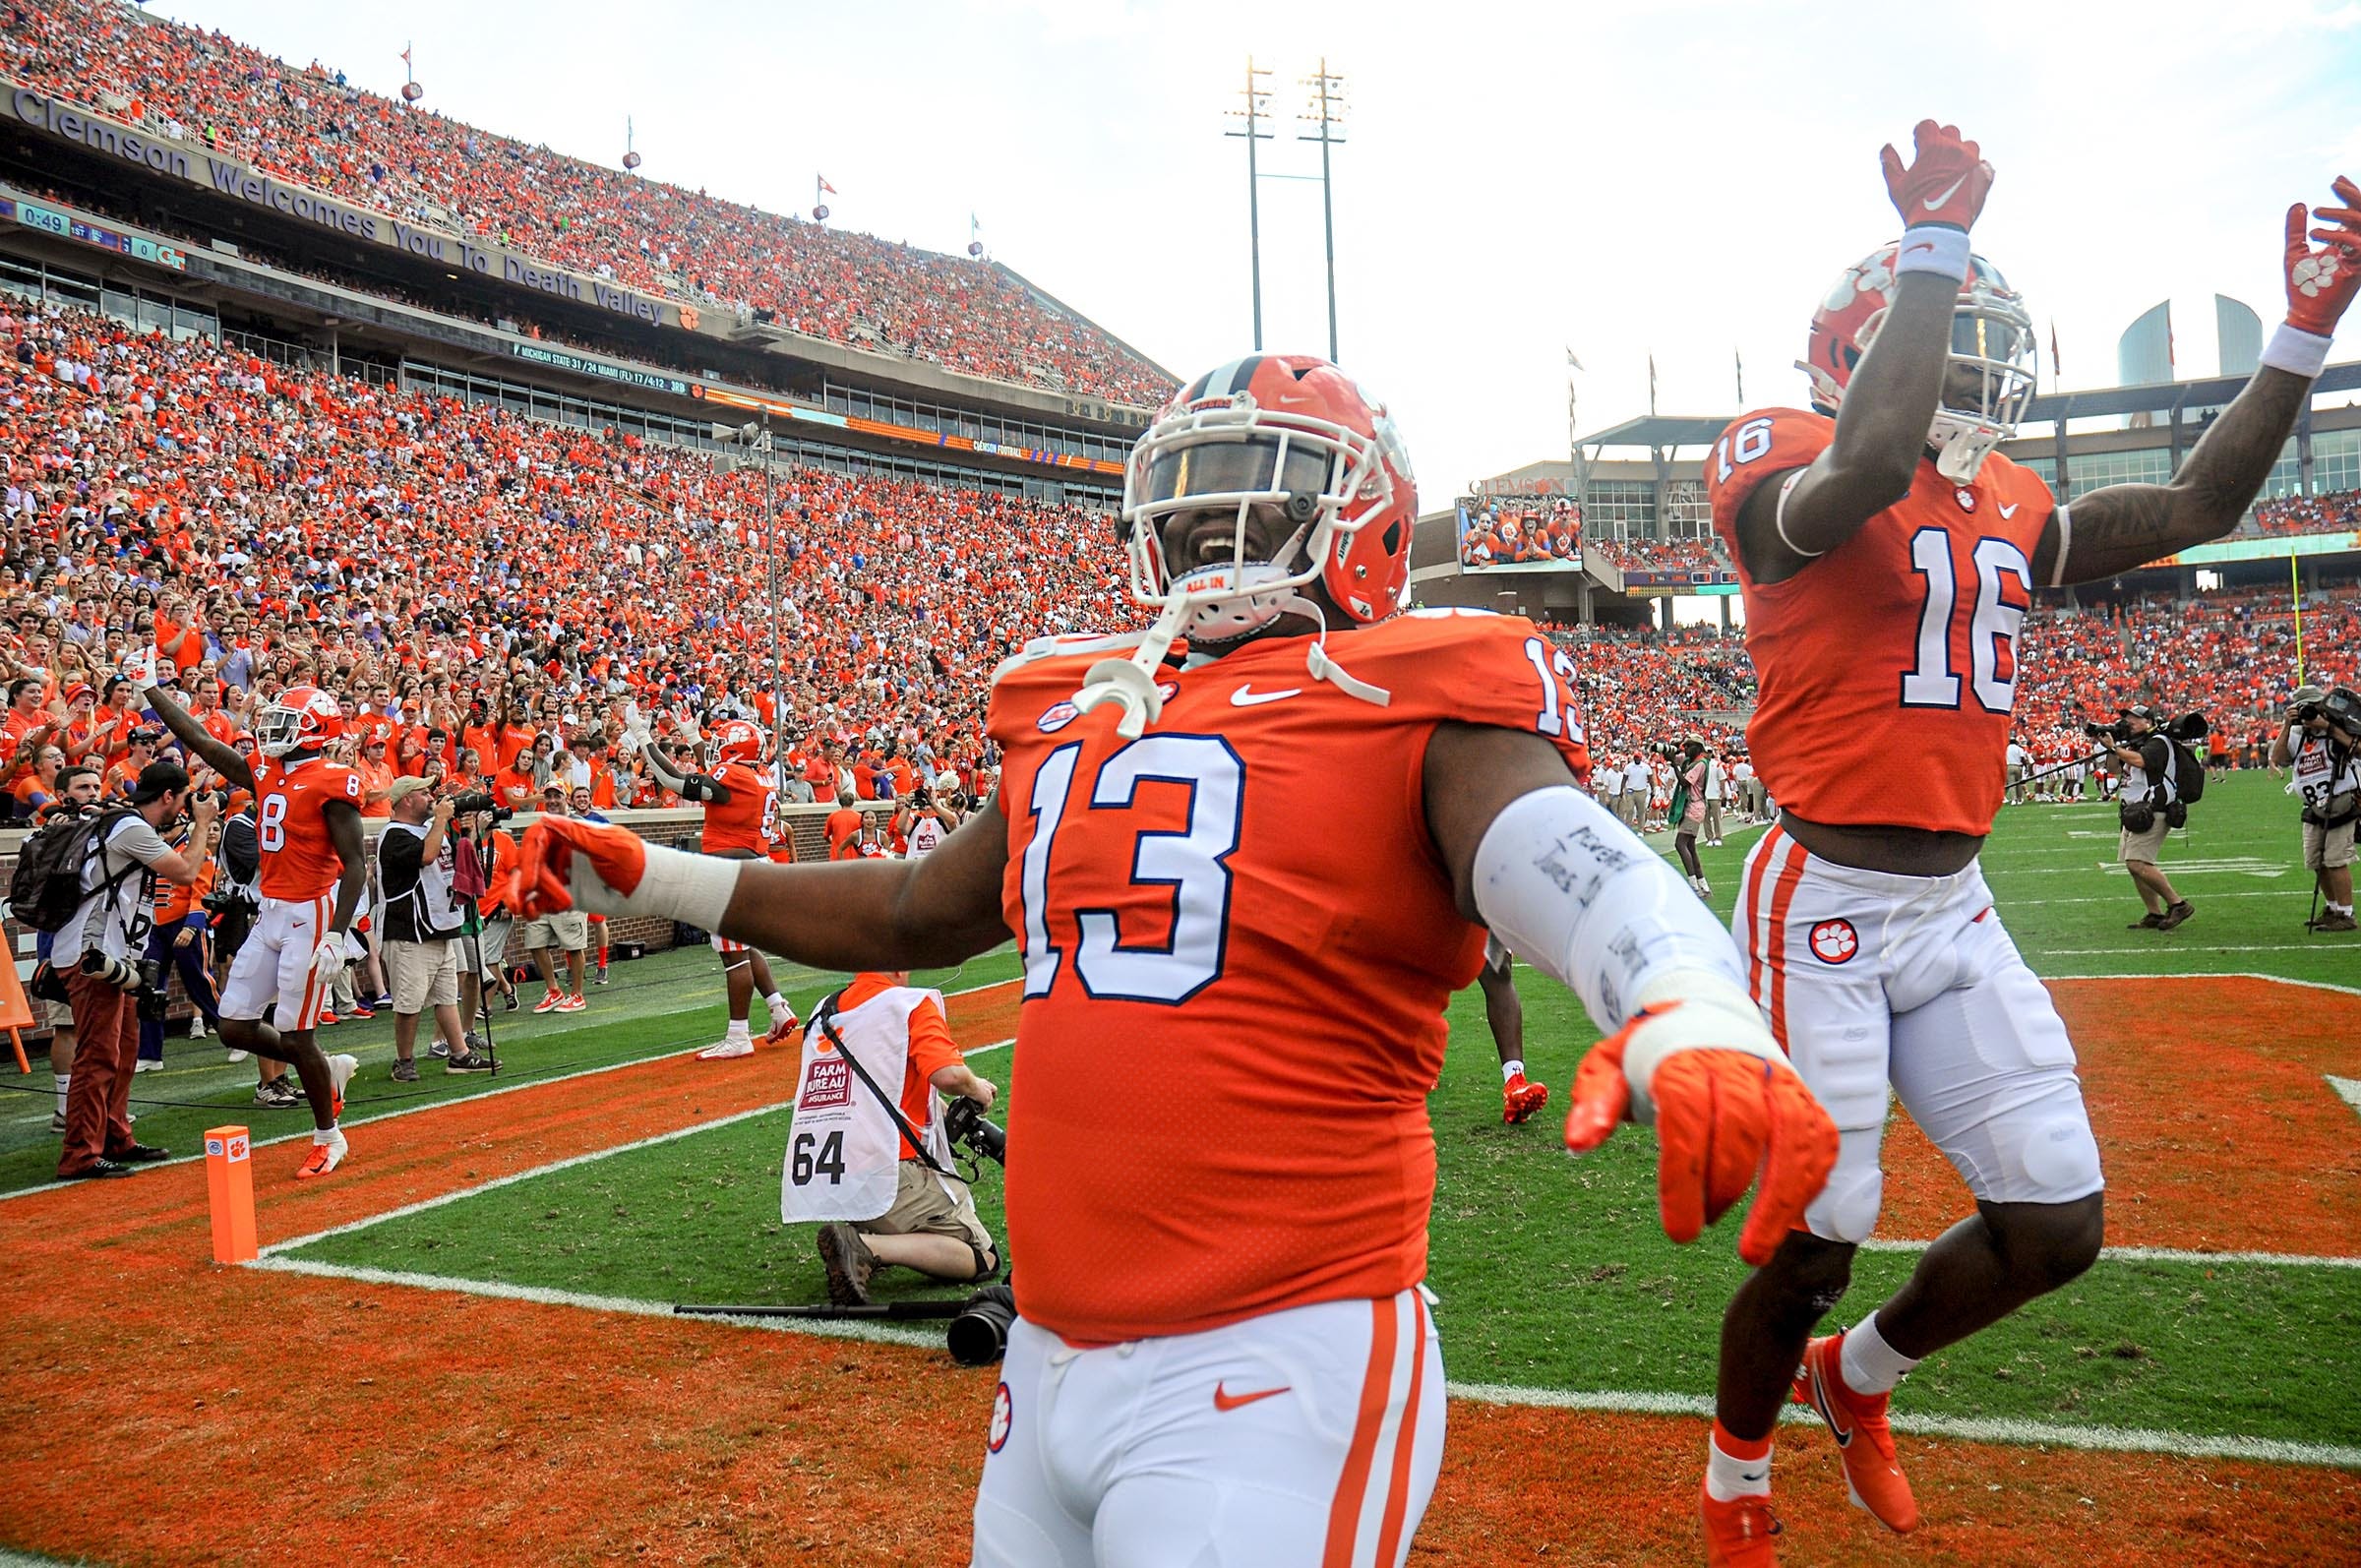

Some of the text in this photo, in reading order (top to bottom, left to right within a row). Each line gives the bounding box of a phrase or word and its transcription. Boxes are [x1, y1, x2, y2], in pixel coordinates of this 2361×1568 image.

[14, 88, 665, 328] Clemson Welcomes You To Death Valley
[25, 209, 62, 231] 0:49
[521, 346, 551, 363] MICHIGAN
[552, 354, 571, 367] STATE
[598, 364, 618, 378] MIAMI
[1716, 417, 1774, 485] 16
[1469, 479, 1565, 497] CLEMSN
[1186, 575, 1225, 593] ALL IN
[1900, 524, 2032, 716] 16
[346, 773, 360, 797] 8
[712, 766, 727, 781] 8
[260, 793, 288, 854] 8
[1021, 730, 1246, 1006] 13
[814, 1063, 846, 1078] FARM
[791, 1130, 846, 1186] 64
